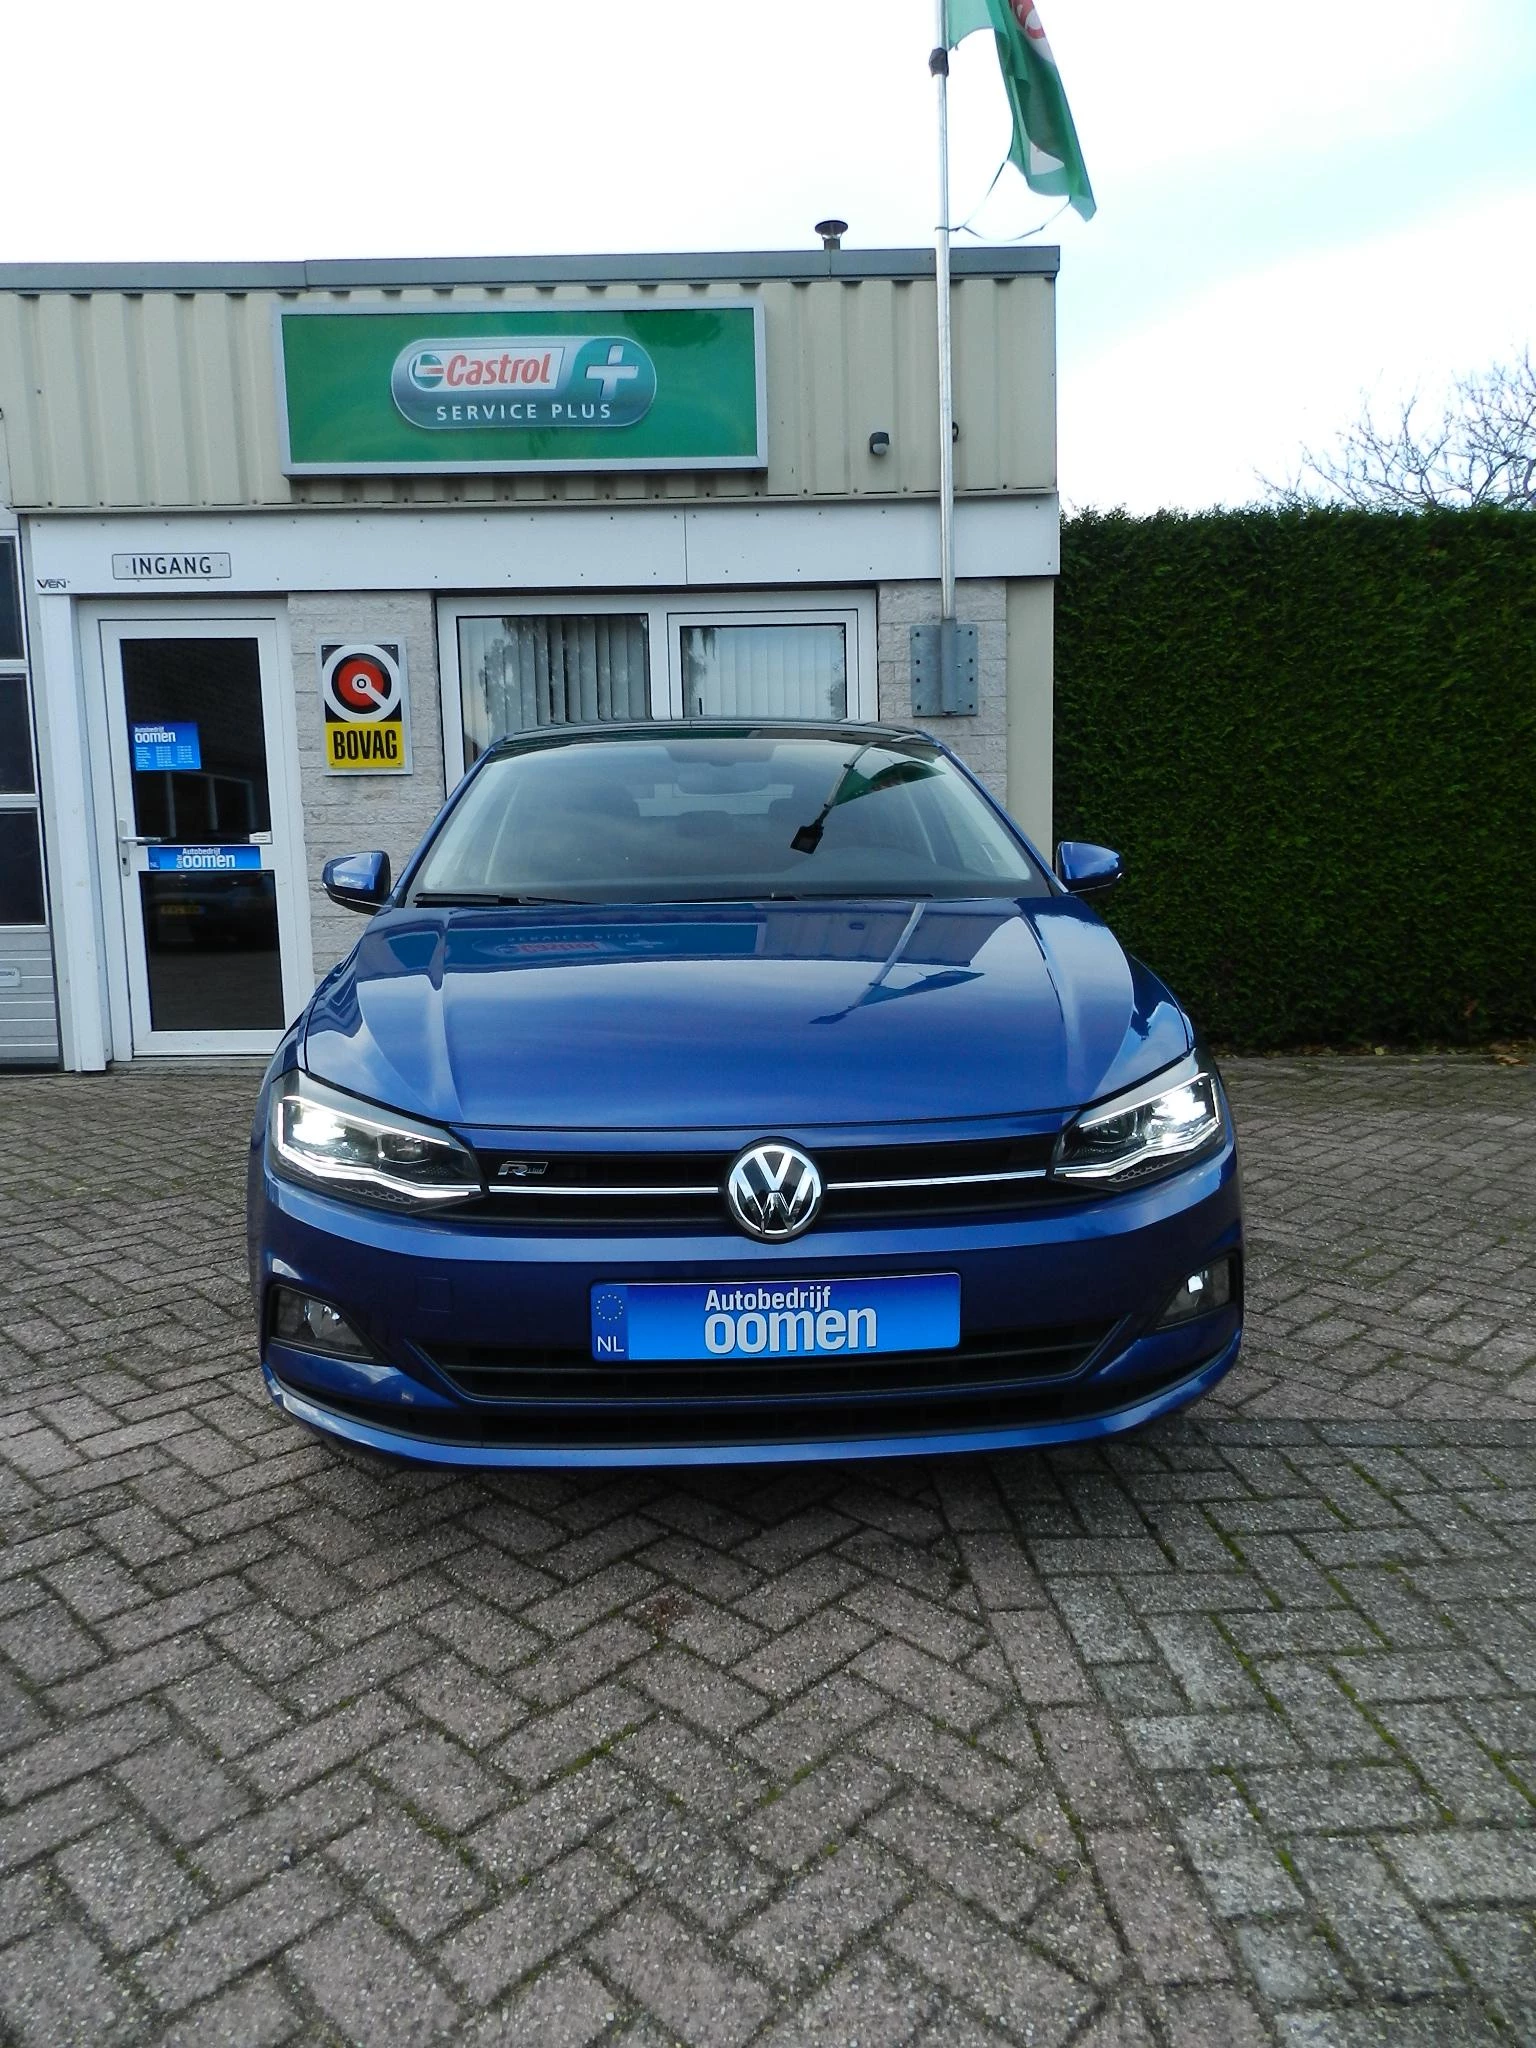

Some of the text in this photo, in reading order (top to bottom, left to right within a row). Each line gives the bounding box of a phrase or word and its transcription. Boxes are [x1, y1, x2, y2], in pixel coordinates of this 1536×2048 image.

[446, 353, 551, 386] Castrol
[436, 403, 612, 421] SERVICE PLUS
[132, 557, 212, 575] INGANG
[135, 732, 176, 743] oomen
[333, 730, 398, 760] BOVAG
[182, 848, 221, 856] Autobedrijf
[183, 855, 236, 868] oomen
[704, 1286, 831, 1313] Autobedrijf
[704, 1307, 877, 1354] oomen
[597, 1336, 625, 1353] NL
